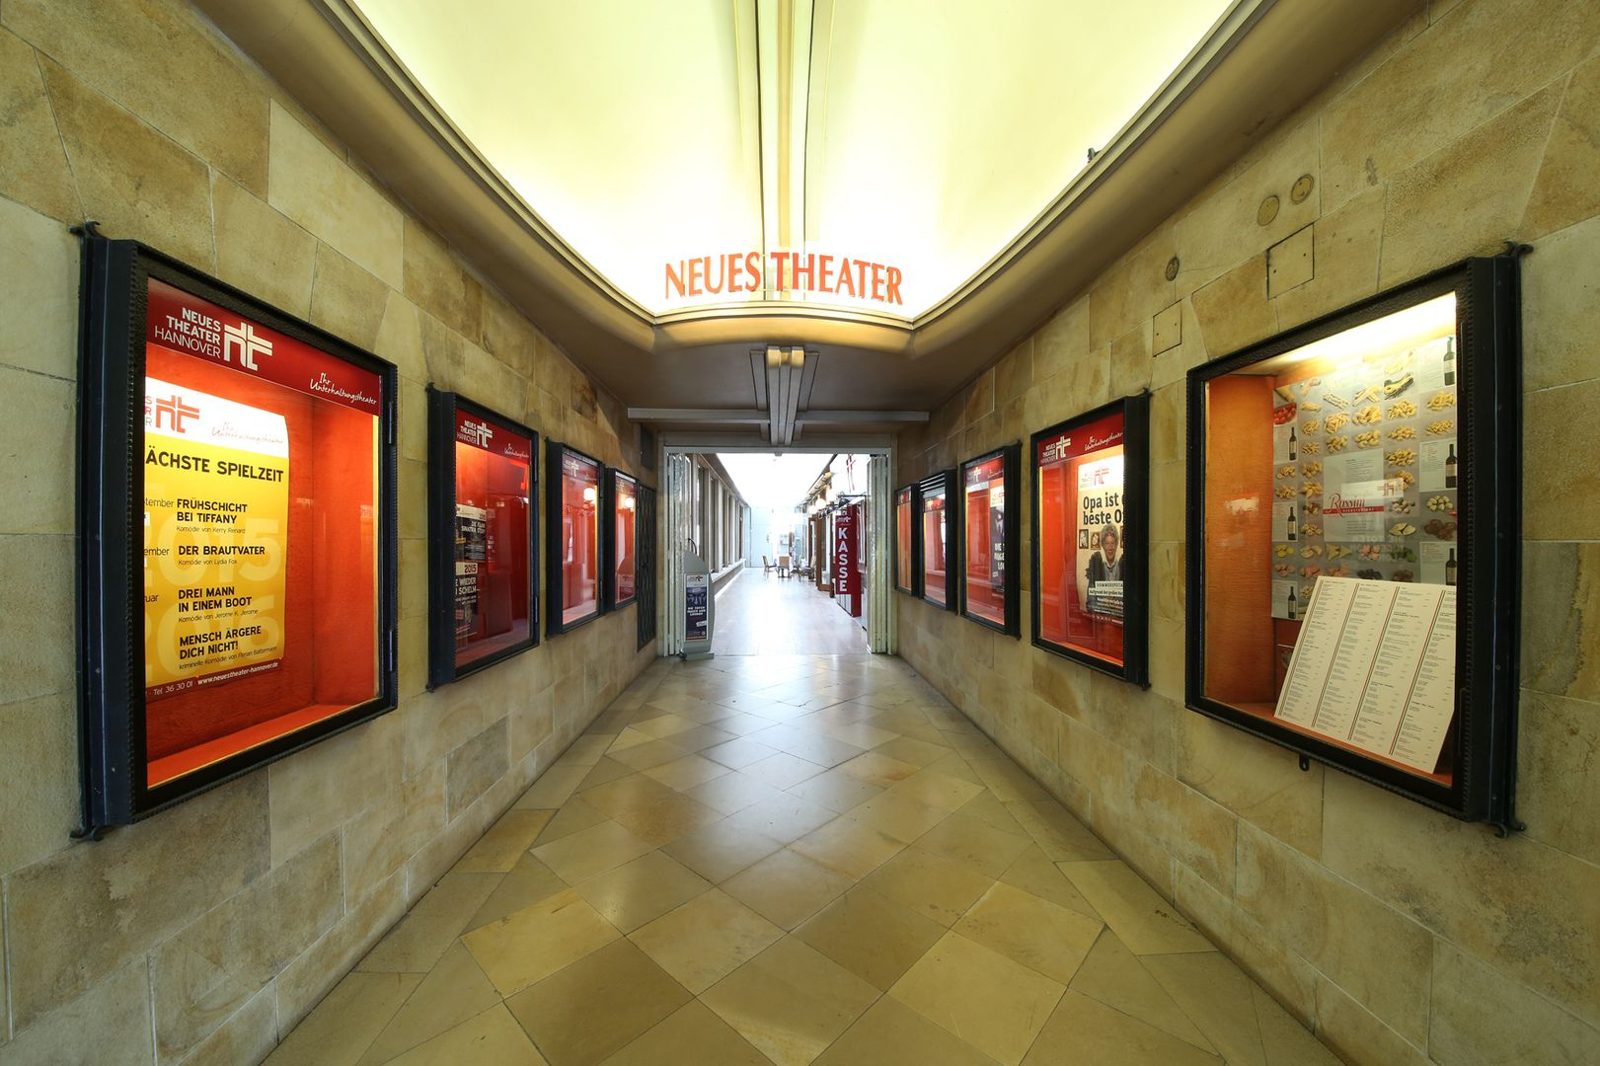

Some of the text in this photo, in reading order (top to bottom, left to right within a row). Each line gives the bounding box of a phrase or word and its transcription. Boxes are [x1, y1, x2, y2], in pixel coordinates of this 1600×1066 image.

[665, 252, 903, 305] NEUES THEATER
[182, 307, 221, 332] NEUES
[166, 315, 221, 346] THEATER
[154, 325, 221, 359] HANNOVER
[145, 445, 284, 482] ÄCHSTE SPIELZEIT
[144, 497, 248, 512] tember FRÜHSCHICHT
[1084, 496, 1102, 513] Opa
[1105, 492, 1119, 508] ist
[177, 512, 238, 524] BEI TIFFANY
[1083, 510, 1111, 526] beste
[178, 546, 199, 556] DER
[203, 546, 265, 555] BRAUTVATER
[838, 528, 848, 592] KASSE
[144, 586, 235, 602] uar DREI MANN
[179, 597, 252, 612] IN EINEM BOOT
[180, 625, 262, 647] MENSCH ÄRGERE
[180, 641, 238, 660] DICH NICHT!
